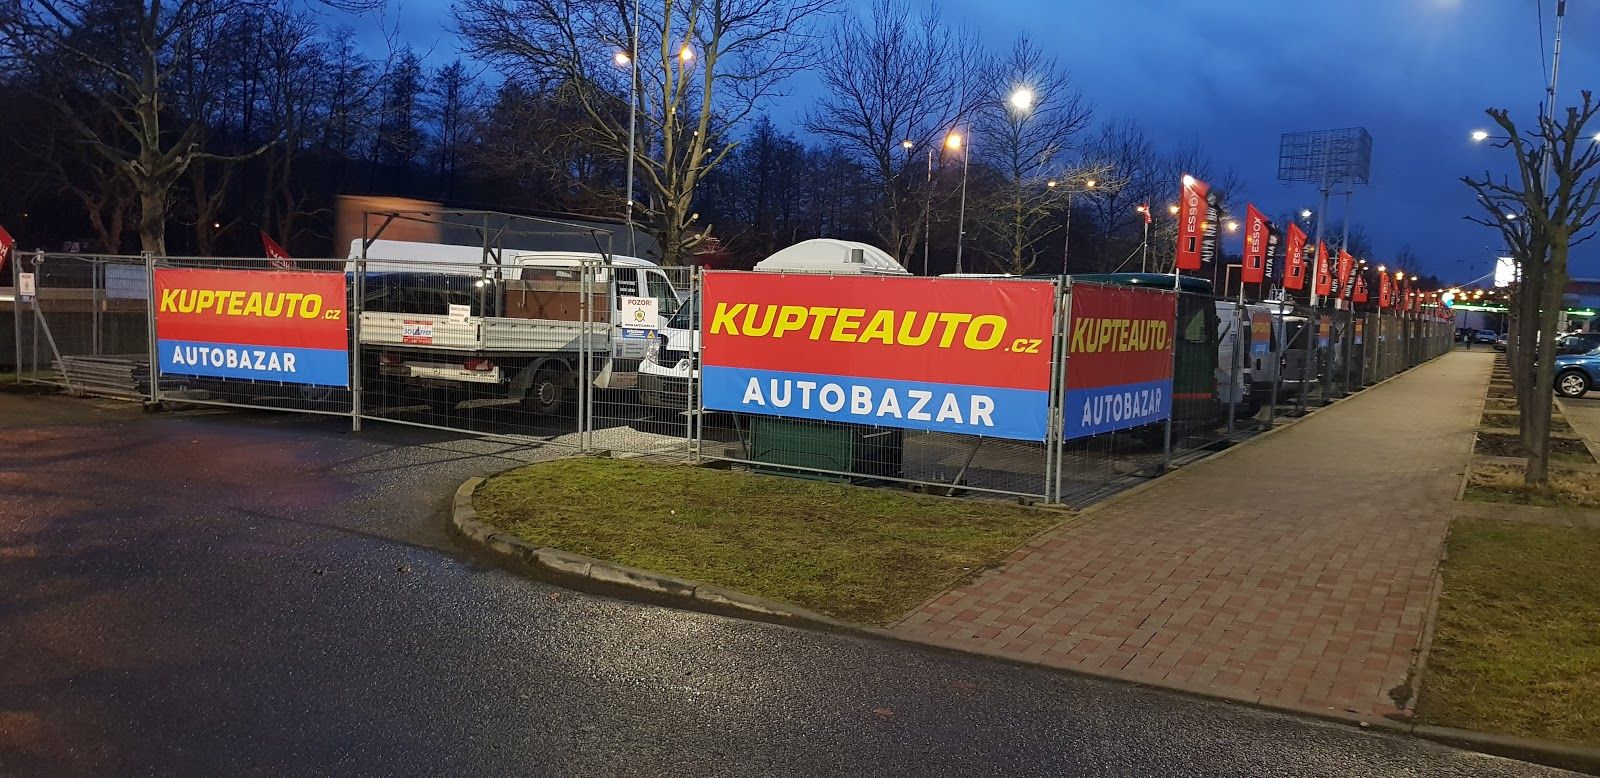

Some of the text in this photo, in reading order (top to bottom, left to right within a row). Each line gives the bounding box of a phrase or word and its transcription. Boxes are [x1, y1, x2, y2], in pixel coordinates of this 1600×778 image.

[1251, 217, 1262, 253] ESSOX
[1267, 246, 1276, 257] NA
[1264, 258, 1274, 278] AUTA
[1070, 317, 1172, 353] KUPTEAUTO
[172, 345, 297, 373] AUTOBAZAR
[741, 376, 996, 427] AUTOBAZAR
[1081, 387, 1162, 428] AUTOBAZAR
